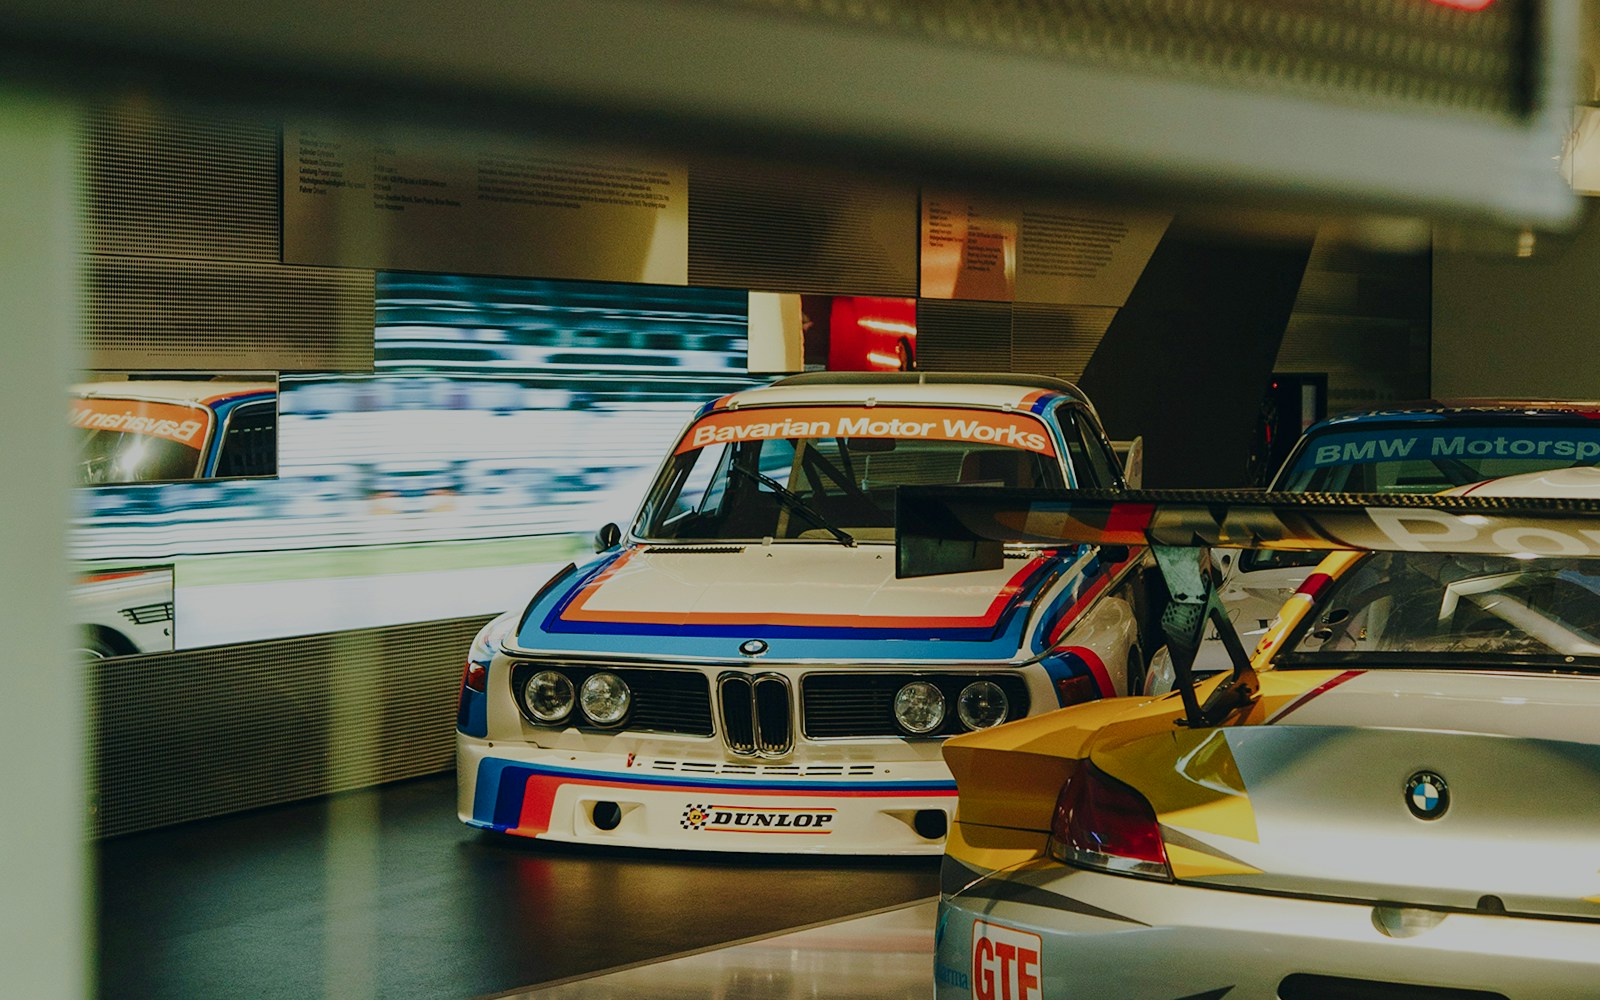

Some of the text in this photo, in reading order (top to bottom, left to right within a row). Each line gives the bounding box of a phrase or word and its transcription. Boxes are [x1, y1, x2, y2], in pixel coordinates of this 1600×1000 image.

[692, 417, 1046, 451] Bavarian Motor Works
[1315, 436, 1600, 465] BMW Motorsp
[711, 811, 833, 827] DUNLOP
